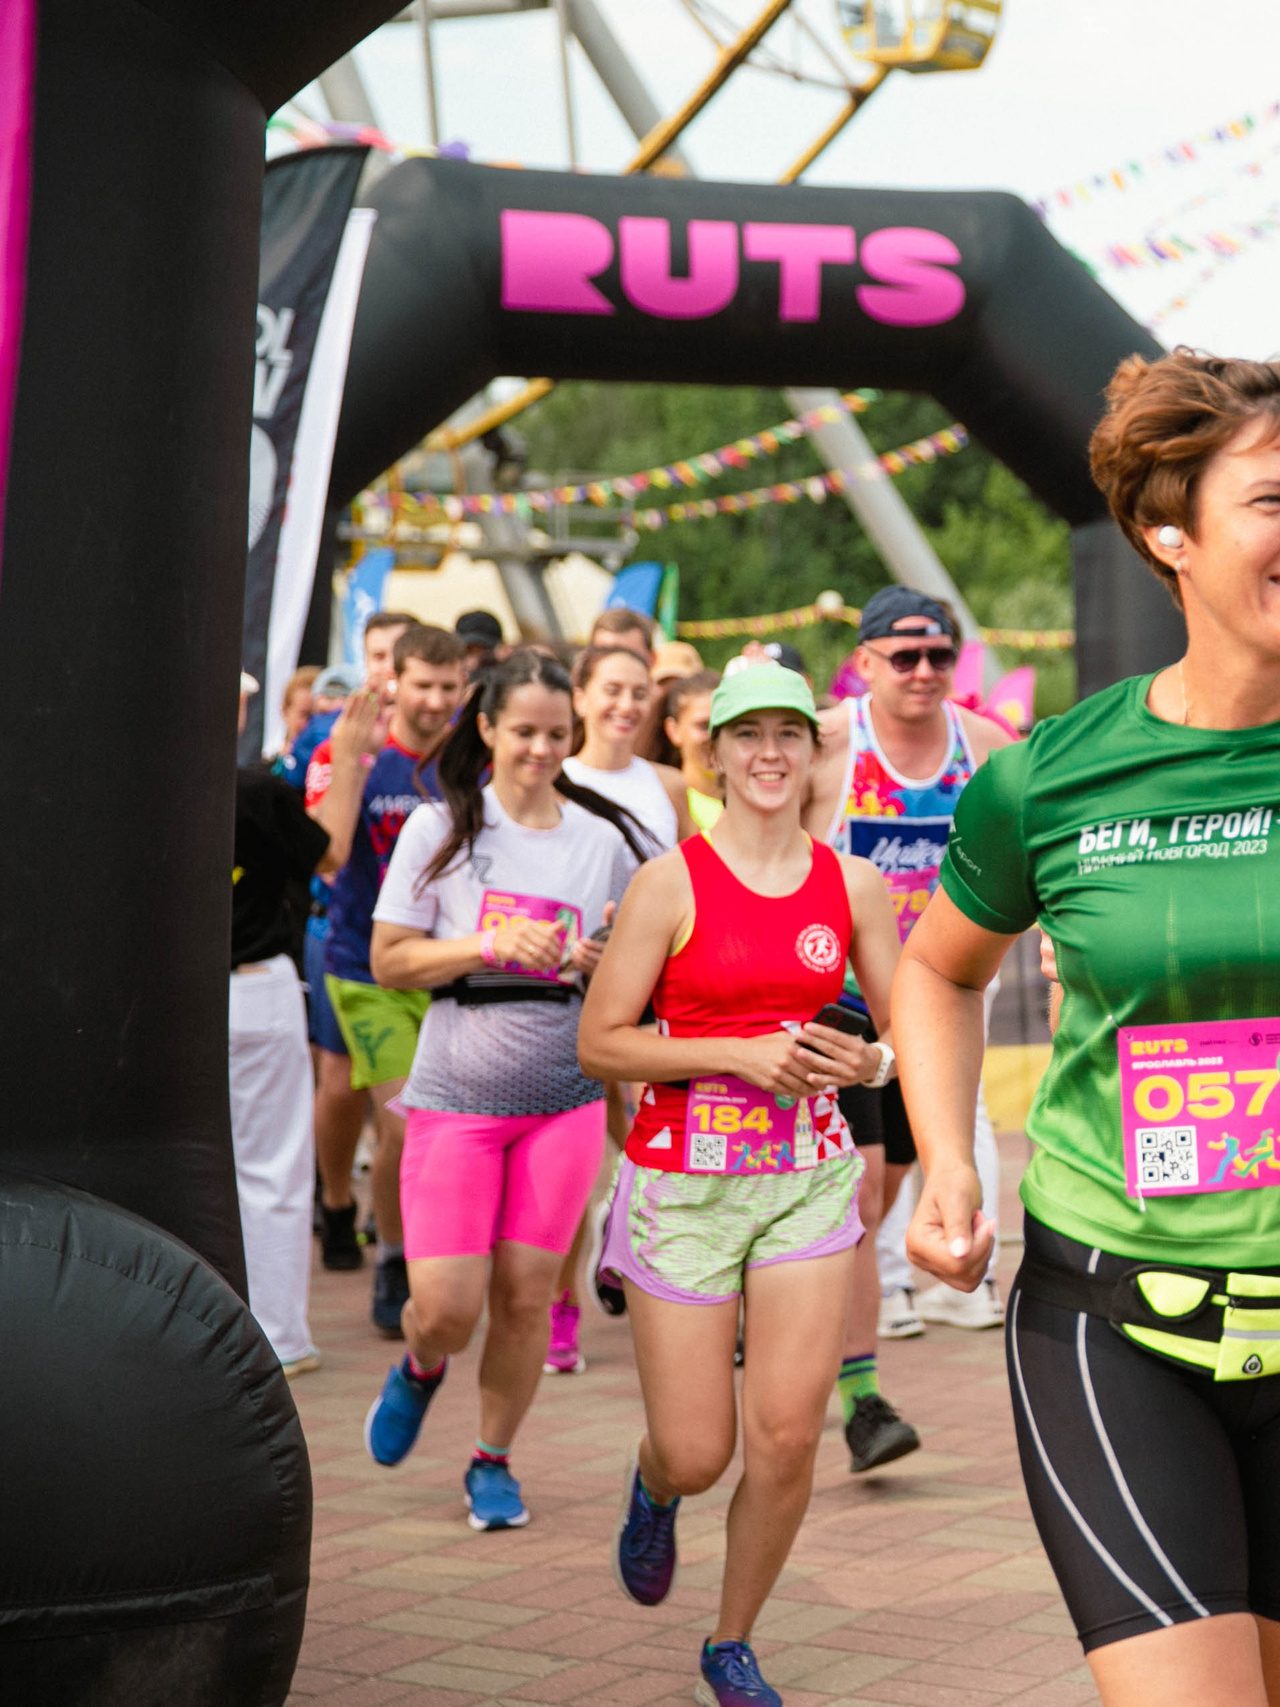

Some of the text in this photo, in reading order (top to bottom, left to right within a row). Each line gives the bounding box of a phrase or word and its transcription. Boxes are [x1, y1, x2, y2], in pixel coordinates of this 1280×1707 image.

[500, 208, 966, 328] RUTS
[1078, 806, 1273, 855] БЕГИ, ГЕРОЙ!
[1231, 838, 1268, 856] 2023
[1130, 1038, 1188, 1056] RUTS
[1133, 1069, 1280, 1122] 057
[692, 1103, 773, 1134] 184
